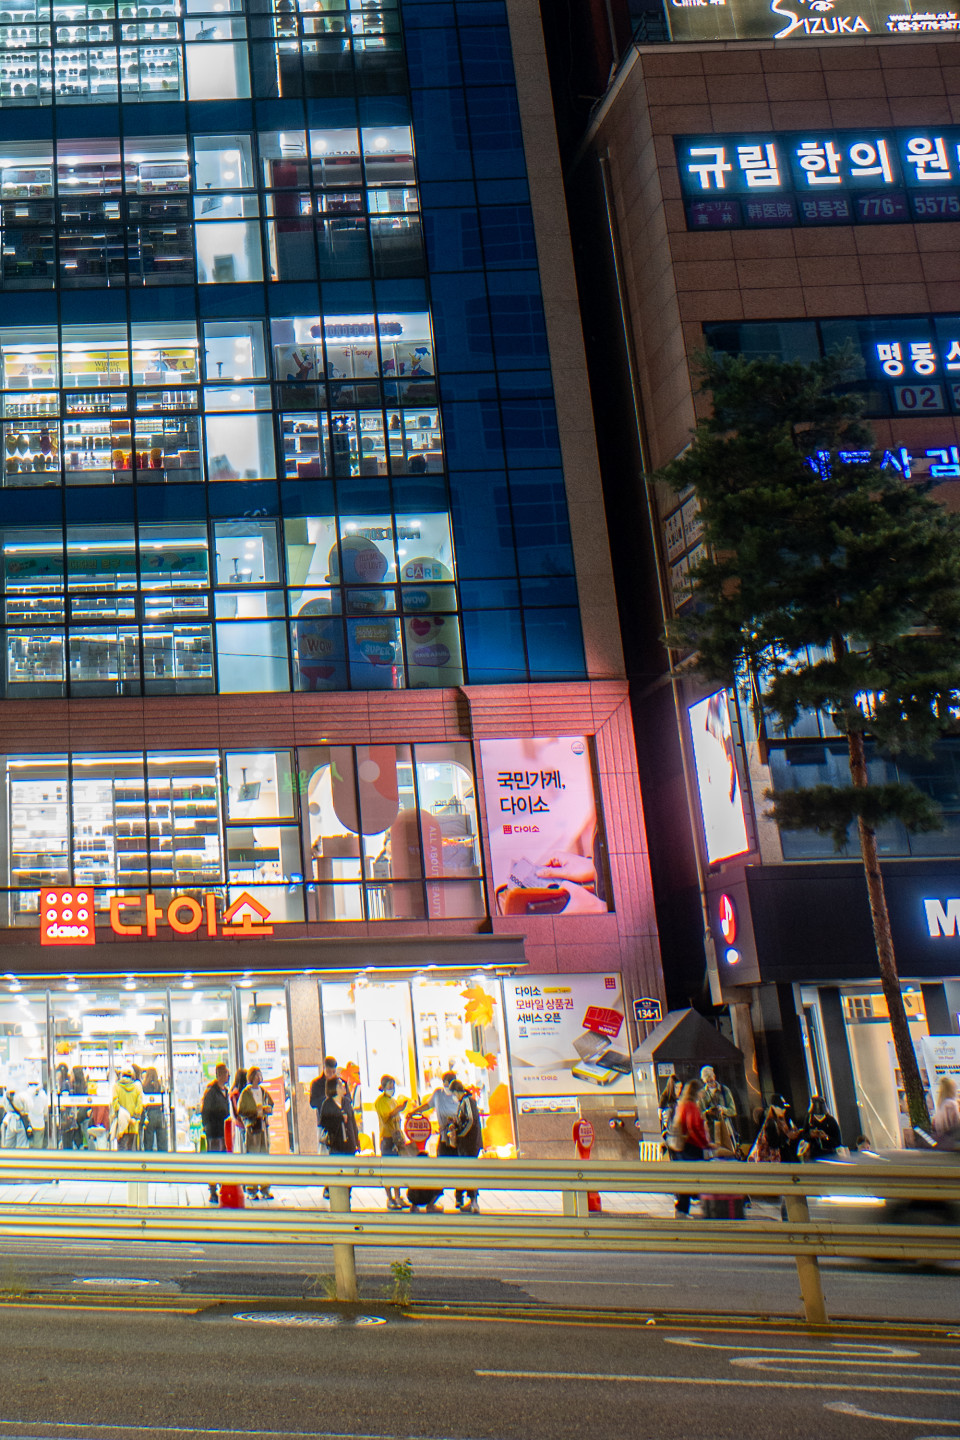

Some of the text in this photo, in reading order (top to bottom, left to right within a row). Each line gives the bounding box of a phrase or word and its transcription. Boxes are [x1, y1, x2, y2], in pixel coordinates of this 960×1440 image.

[688, 137, 952, 189] 규림 한의원
[802, 200, 849, 218] 명동점
[900, 387, 938, 409] 02
[497, 770, 566, 790] 국민가게,
[500, 795, 550, 815] 다이소
[429, 825, 437, 843] ALL
[513, 825, 540, 833] 다이소
[110, 891, 274, 936] 다이소
[515, 986, 541, 996] 다이소
[516, 998, 574, 1010] 모바일 상품권
[518, 1012, 561, 1023] 서비스 오픈
[637, 1009, 659, 1018] 134-1
